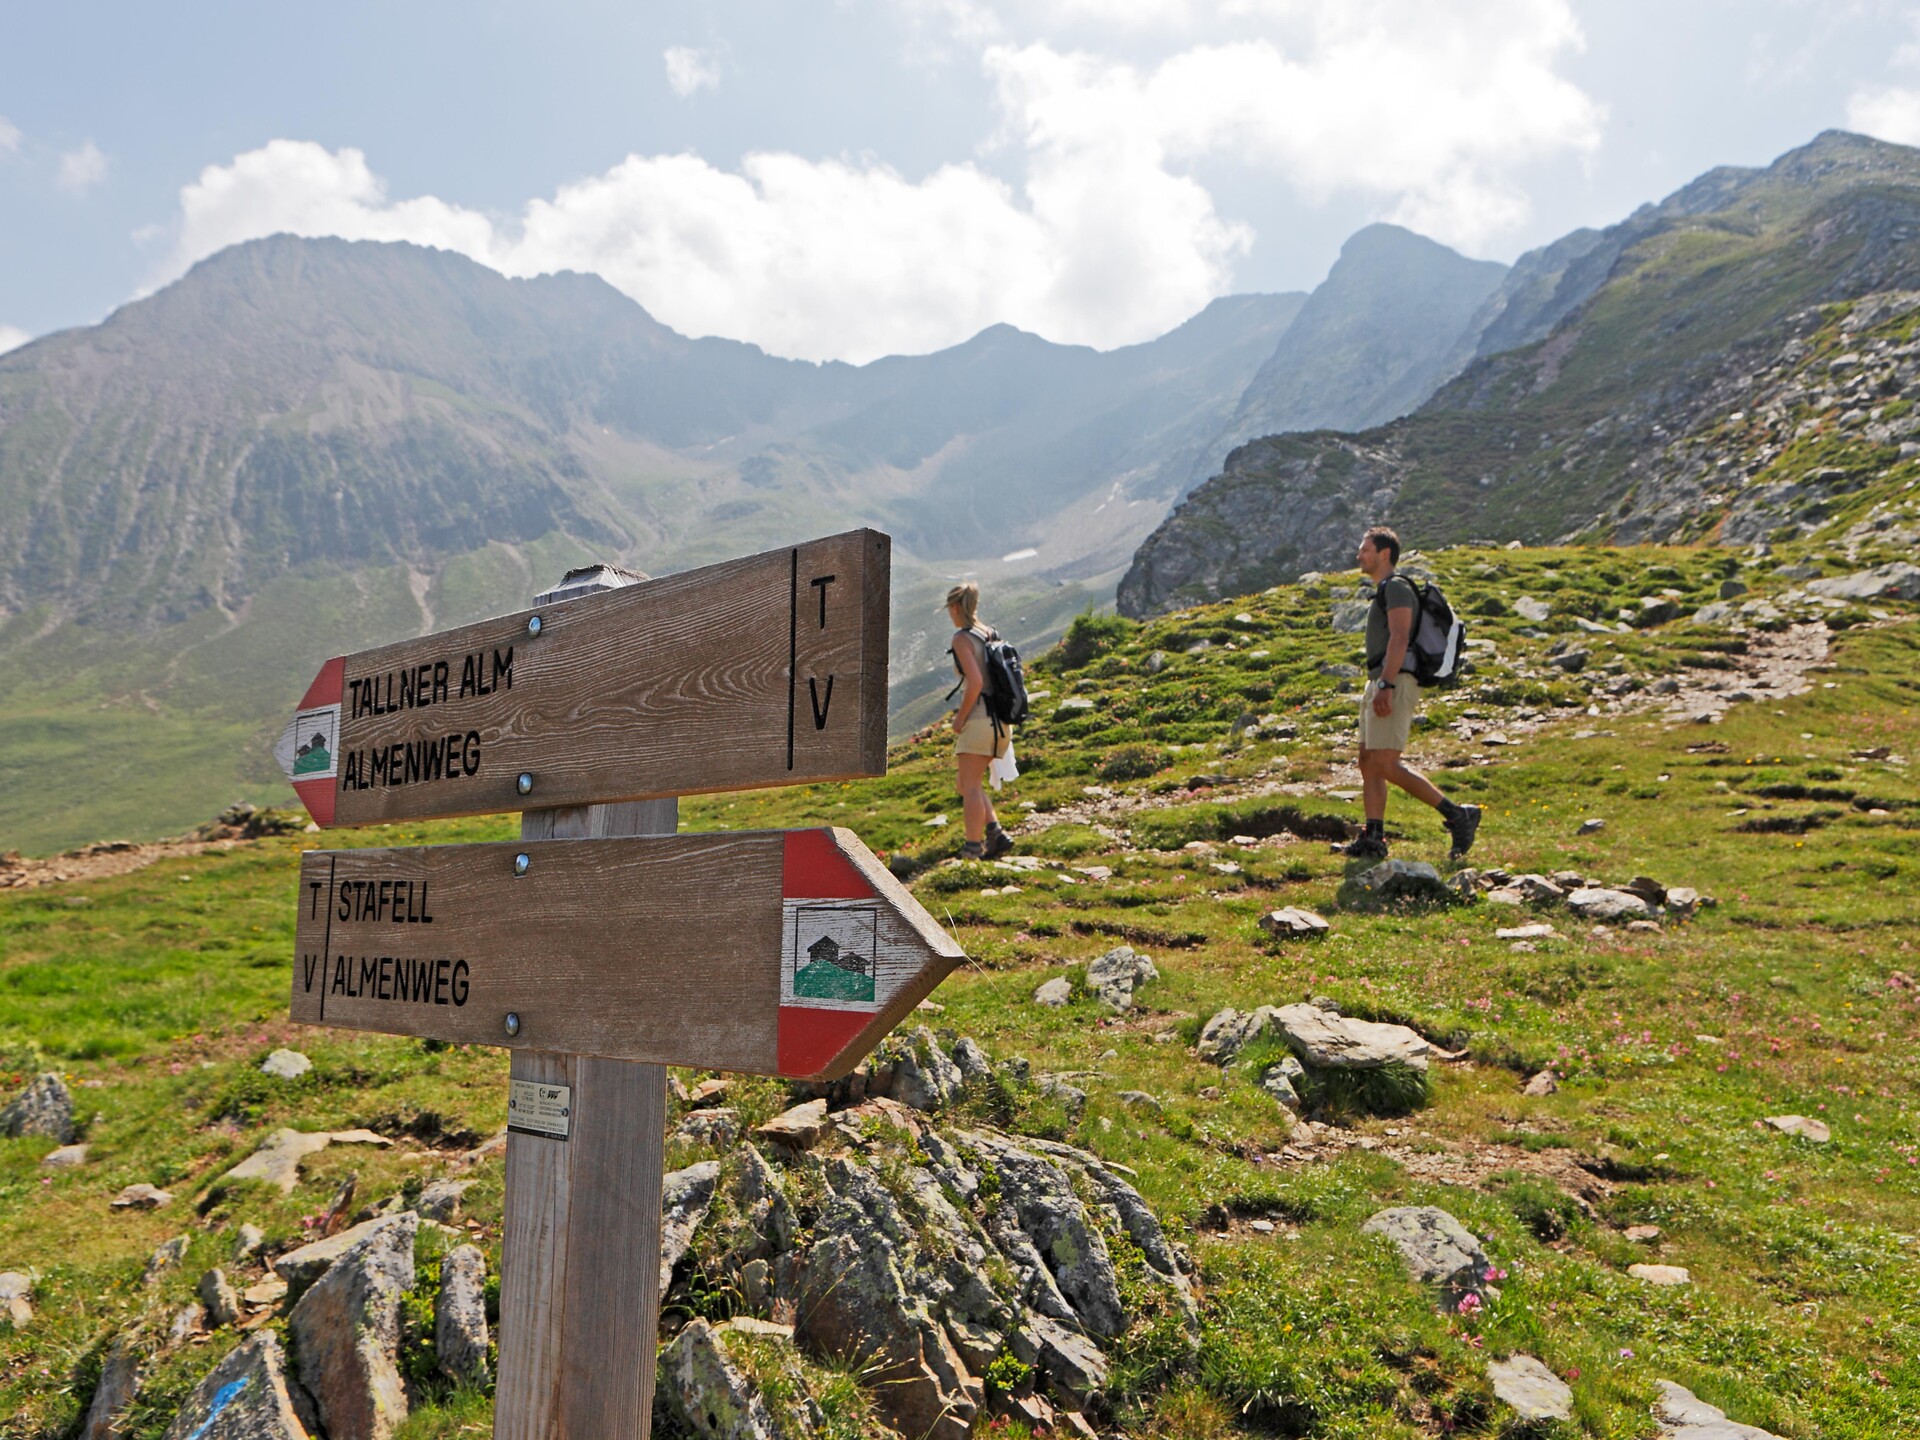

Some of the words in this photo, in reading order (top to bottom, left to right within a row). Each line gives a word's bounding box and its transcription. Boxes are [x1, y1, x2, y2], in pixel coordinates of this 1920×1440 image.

[811, 575, 835, 629] T
[350, 661, 449, 719] TALLNER
[459, 646, 513, 698] ALM
[809, 674, 834, 730] V
[343, 730, 481, 791] ALMENWEG
[310, 882, 322, 920] T
[338, 880, 433, 923] STAFELL
[305, 955, 316, 993] V
[332, 956, 469, 1007] ALMENWEG
